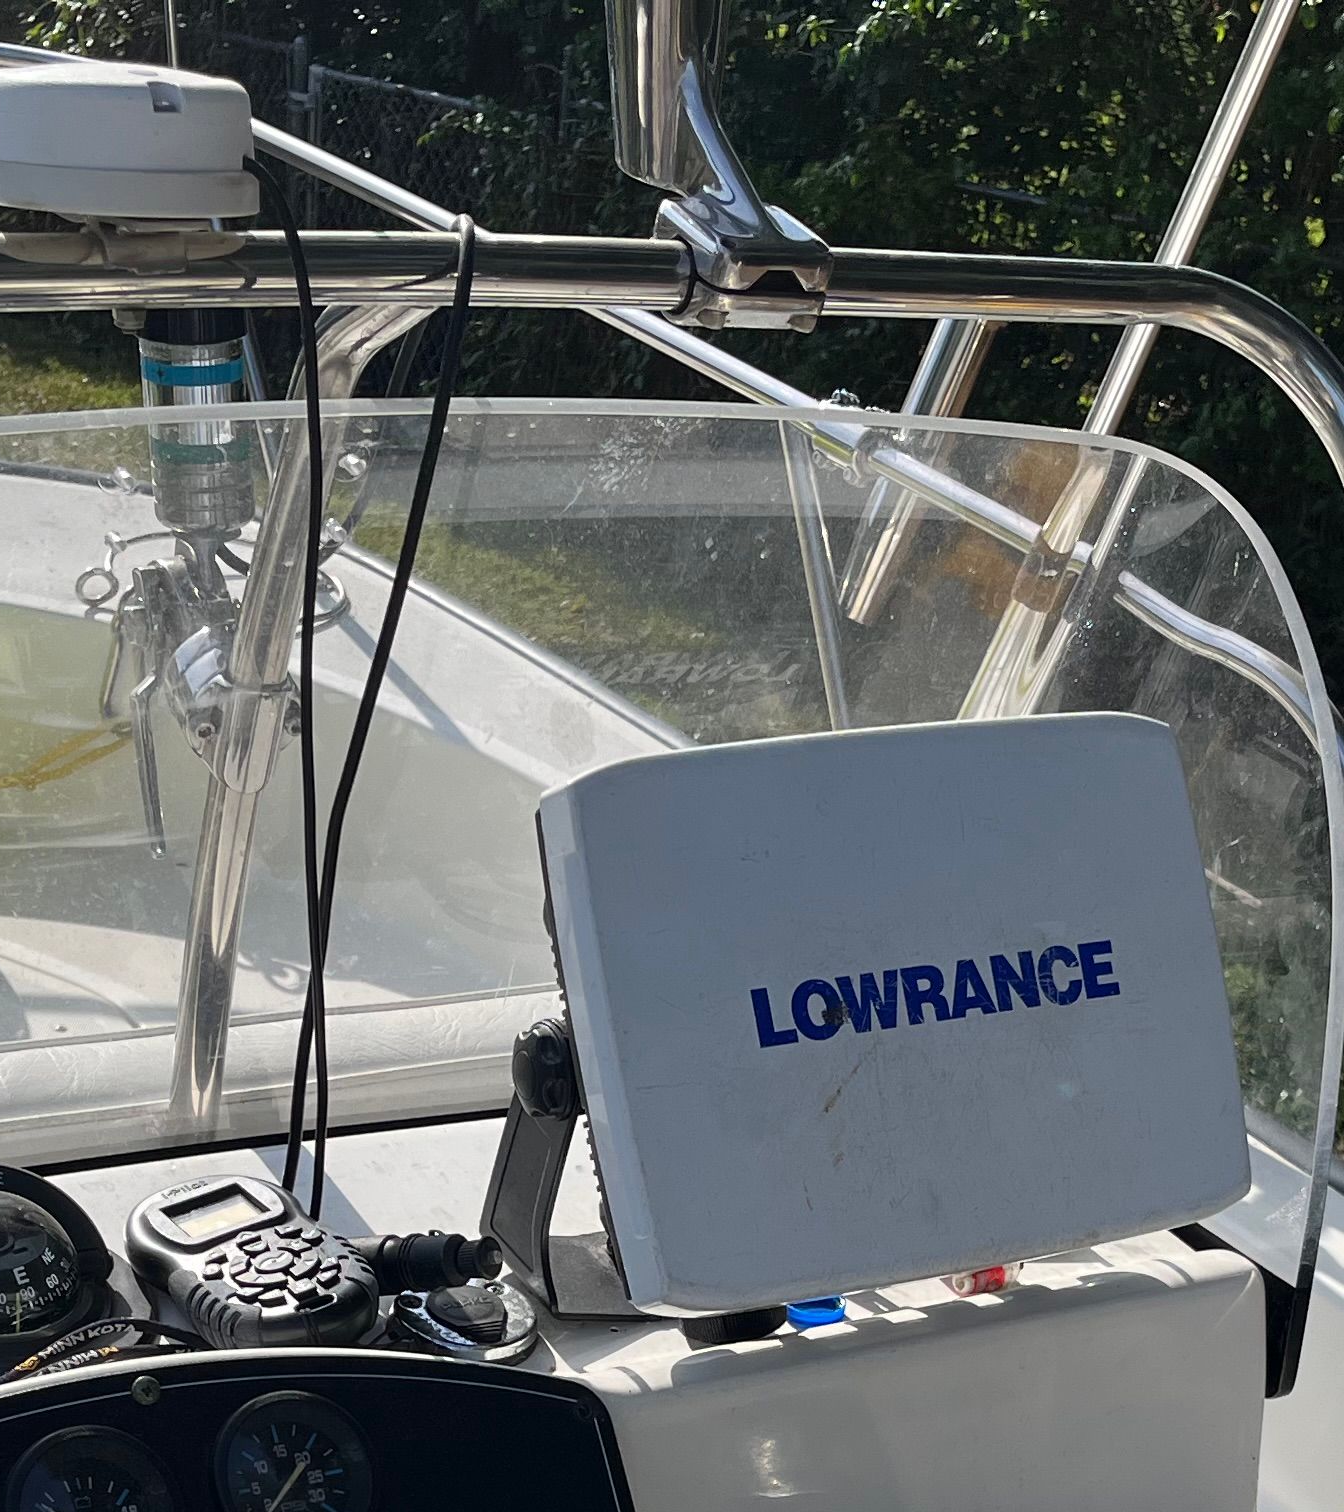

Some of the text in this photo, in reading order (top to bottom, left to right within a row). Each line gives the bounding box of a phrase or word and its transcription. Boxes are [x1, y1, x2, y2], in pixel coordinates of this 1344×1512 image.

[750, 939, 1121, 1049] LOWRANCE
[12, 1265, 30, 1286] E
[41, 1247, 56, 1265] NE
[45, 1273, 60, 1289] 60
[38, 1323, 136, 1360] MINN KOTA
[272, 1443, 288, 1458] 15
[253, 1459, 268, 1475] 10
[307, 1469, 324, 1484] 25
[251, 1481, 262, 1495] 5
[308, 1488, 326, 1503] 30
